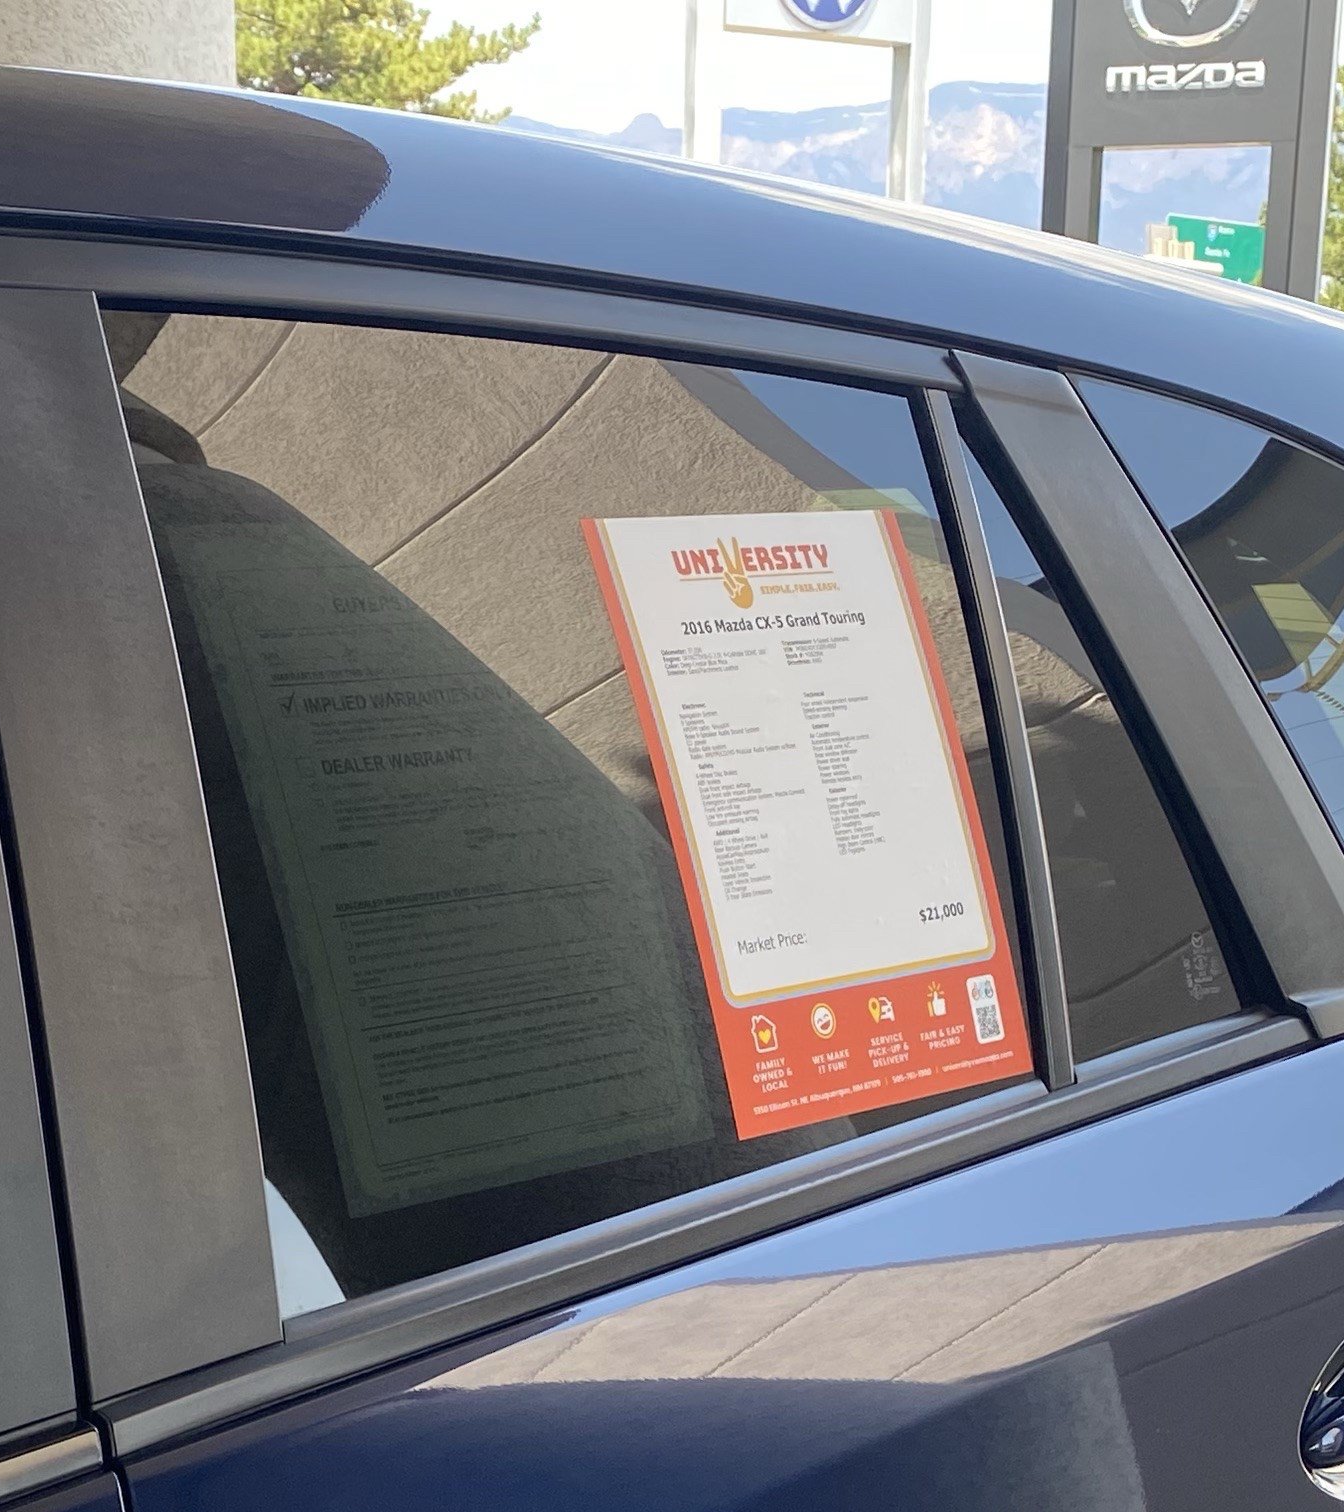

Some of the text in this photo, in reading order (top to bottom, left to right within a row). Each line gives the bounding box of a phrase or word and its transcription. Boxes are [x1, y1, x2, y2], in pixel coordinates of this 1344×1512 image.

[681, 609, 866, 635] 2016 Mazda CX-5 Grand Touring
[303, 694, 367, 714] IMPLIED
[370, 688, 470, 709] WARRANTIES
[321, 747, 474, 776] DEALER WARRANTY
[919, 901, 964, 924] $21,000
[737, 932, 808, 955] Market Price:
[870, 1031, 903, 1047] SERVICE
[920, 1030, 938, 1041] FAIR
[946, 1024, 965, 1035] EASY
[868, 1043, 901, 1058] PICK-UP
[928, 1036, 961, 1050] PRICING
[756, 1057, 785, 1072] FAMILY
[812, 1049, 850, 1065] WE MAKE
[872, 1053, 909, 1068] DELIVERY
[752, 1068, 785, 1083] OWNED
[818, 1060, 848, 1075] IT FUN!
[762, 1080, 789, 1093] LOCAL
